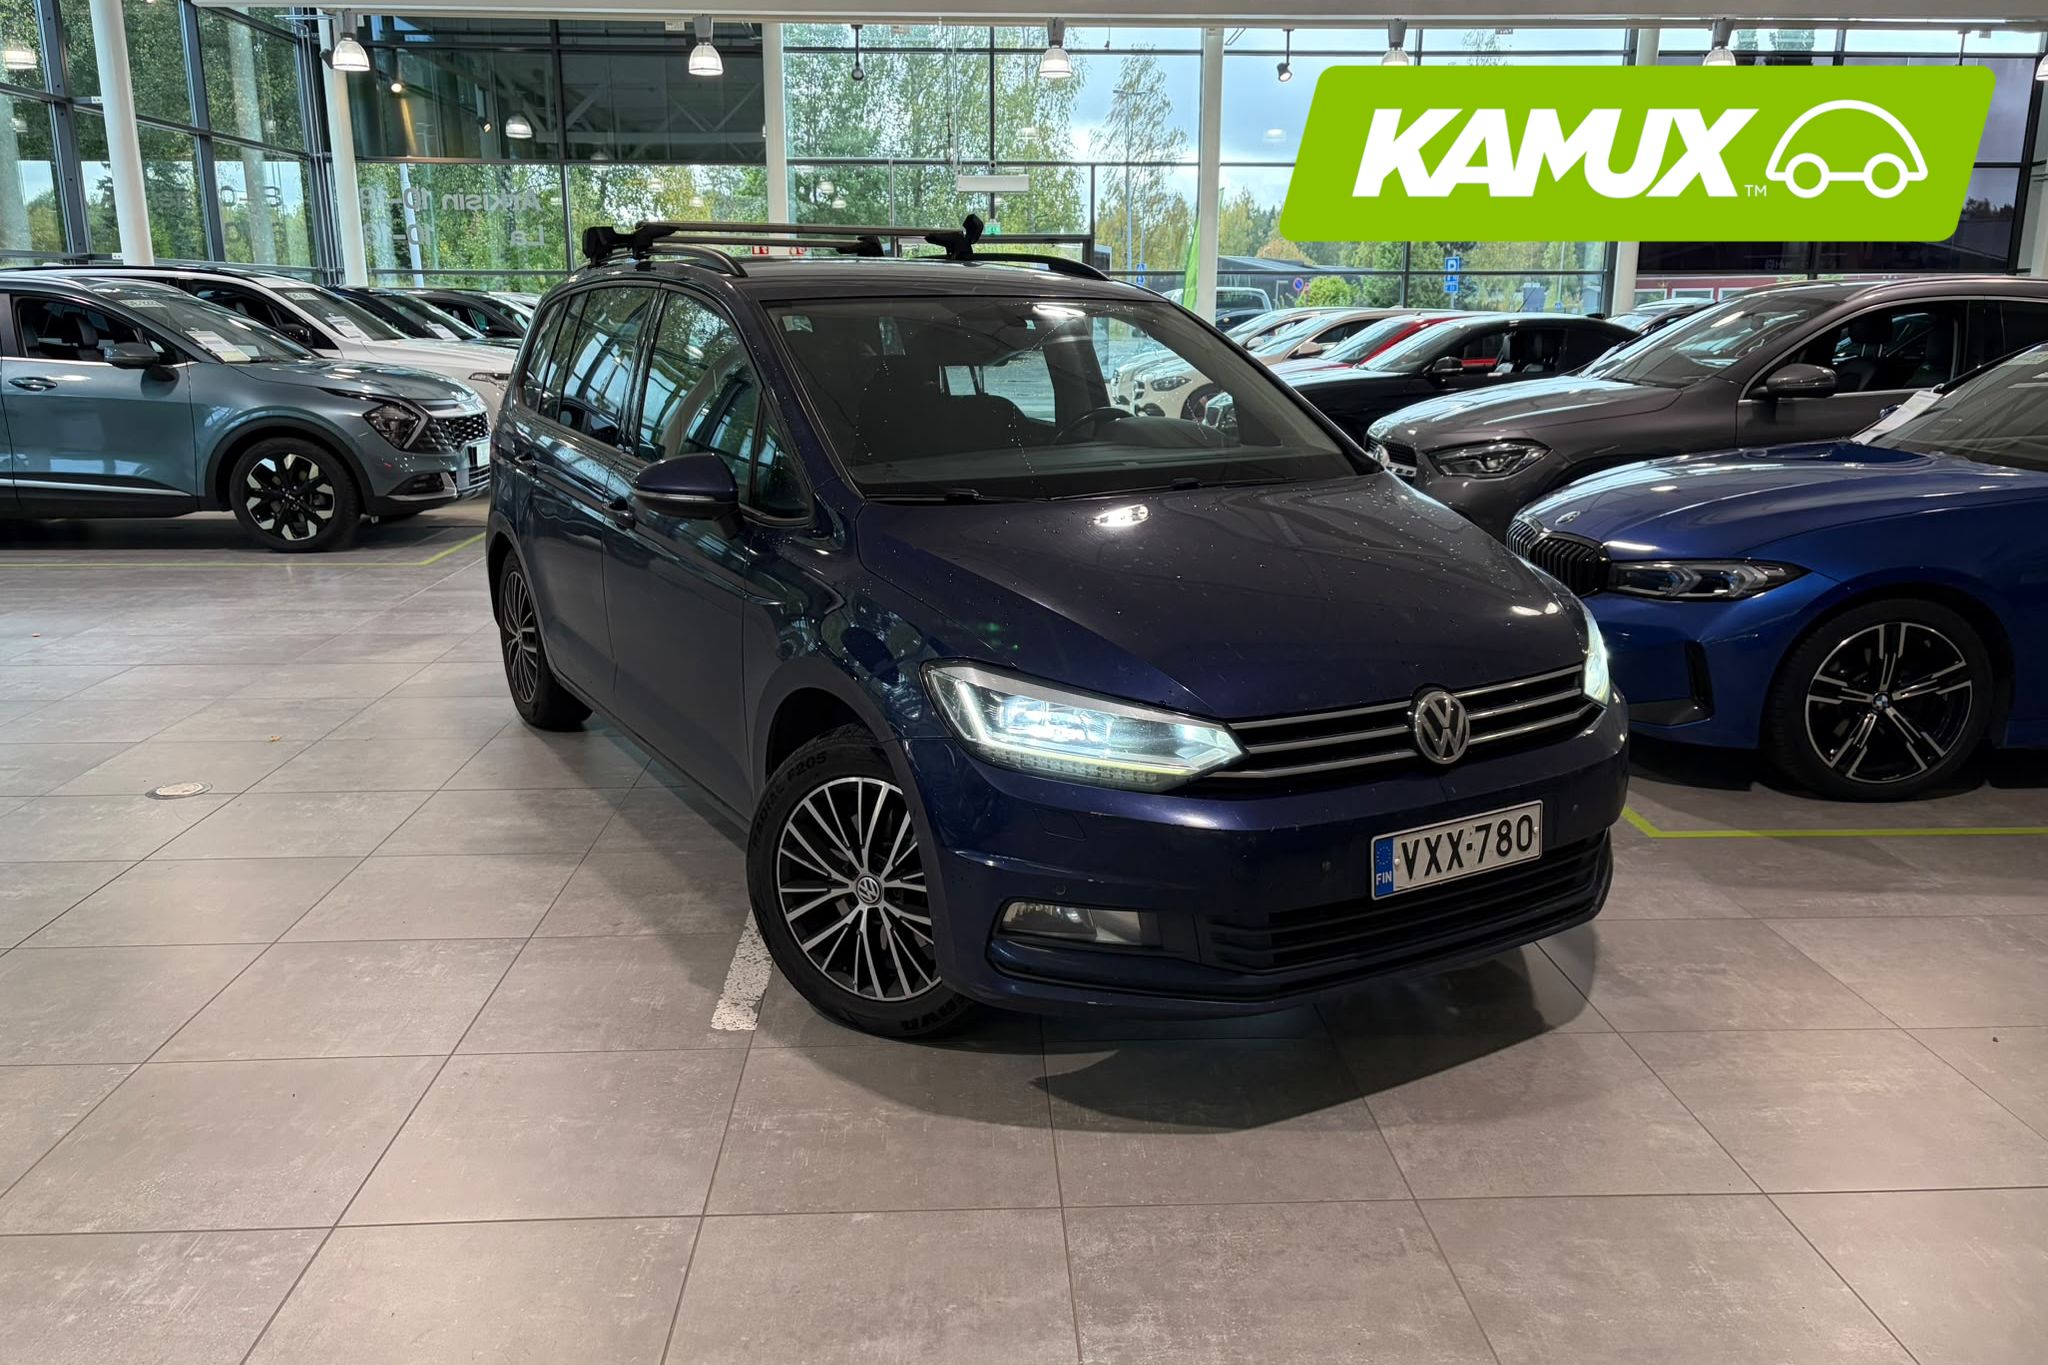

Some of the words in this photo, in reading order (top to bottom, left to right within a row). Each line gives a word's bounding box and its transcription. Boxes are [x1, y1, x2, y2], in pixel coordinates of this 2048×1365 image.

[786, 751, 827, 782] F205
[1401, 815, 1533, 882] VXX-780
[1376, 871, 1392, 886] FIN
